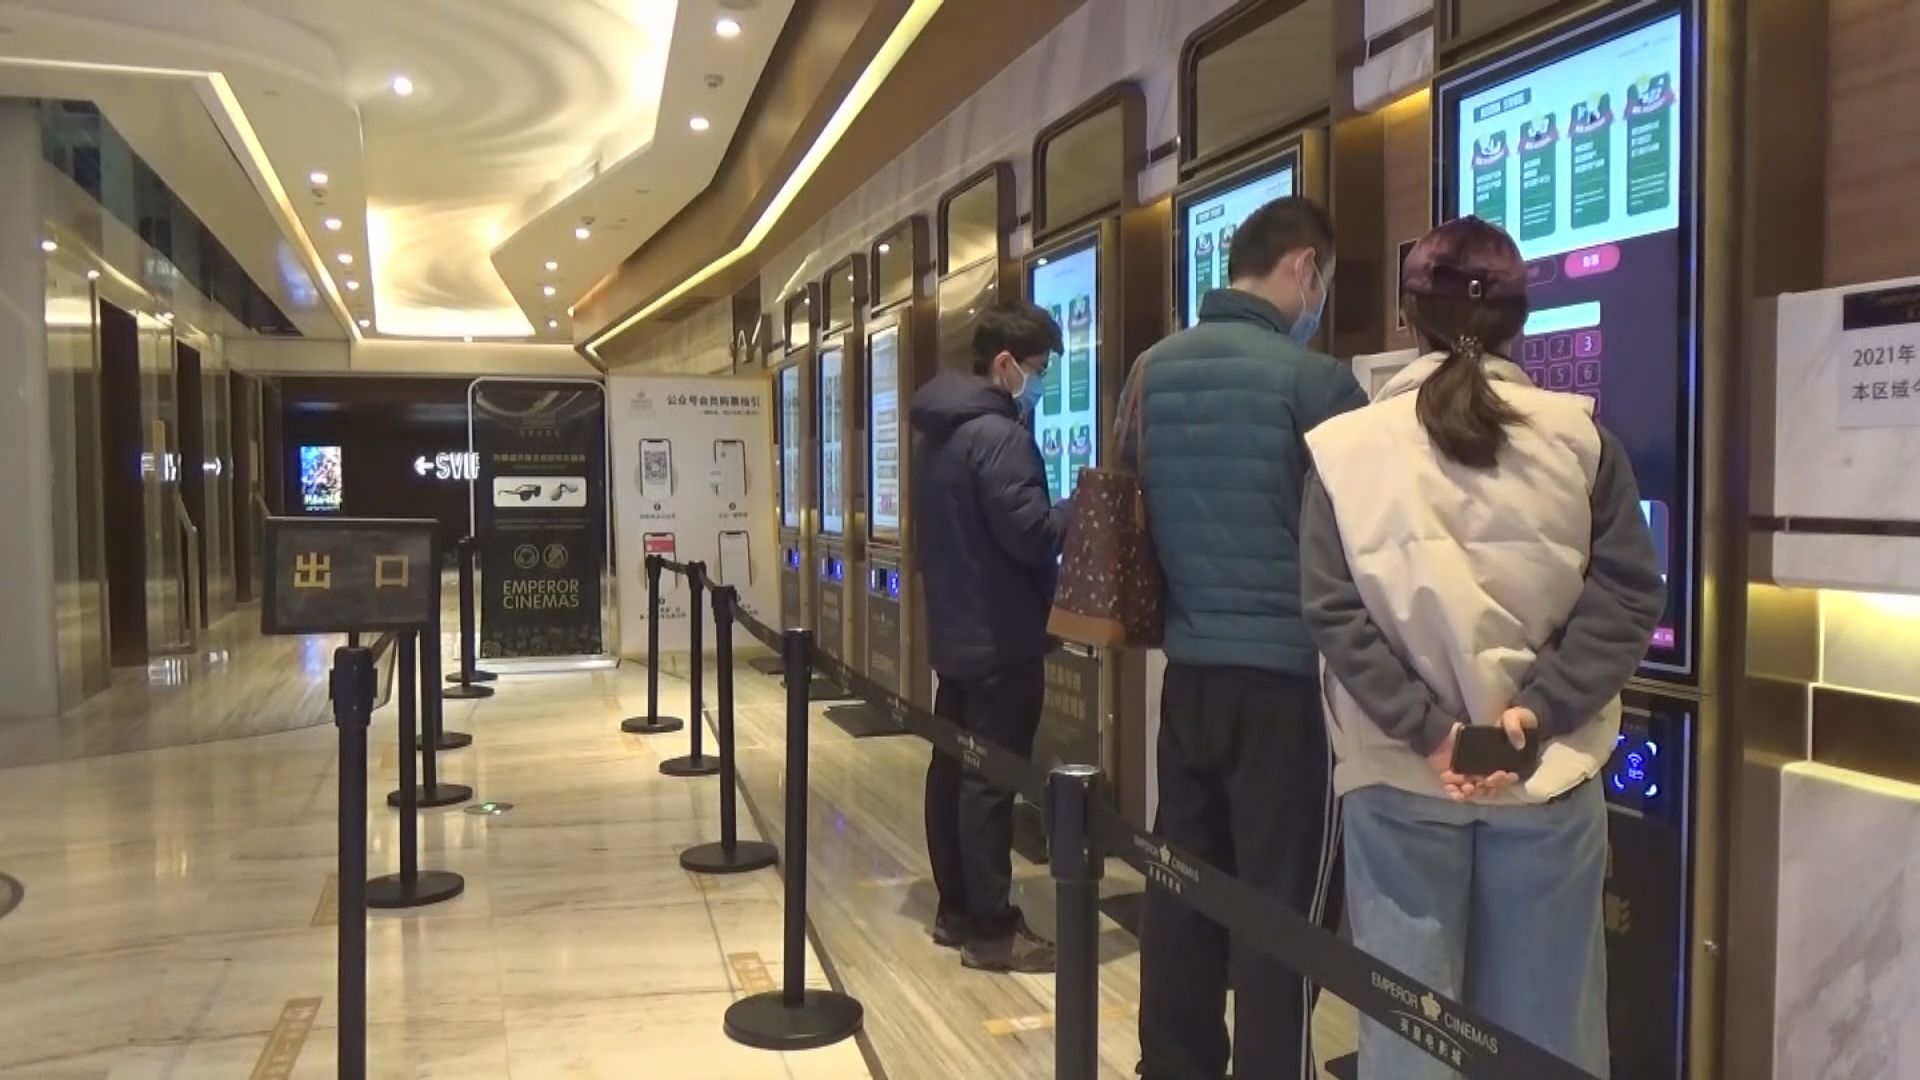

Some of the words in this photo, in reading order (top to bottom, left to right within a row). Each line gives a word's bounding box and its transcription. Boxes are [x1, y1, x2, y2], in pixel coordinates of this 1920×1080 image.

[1584, 336, 1593, 352] 3
[1853, 345, 1916, 367] 2021年
[503, 579, 579, 594] EMPEROR
[503, 594, 579, 609] CINEMAS
[1371, 970, 1418, 1009] EMPEROR
[1444, 1011, 1498, 1053] CINEMAS
